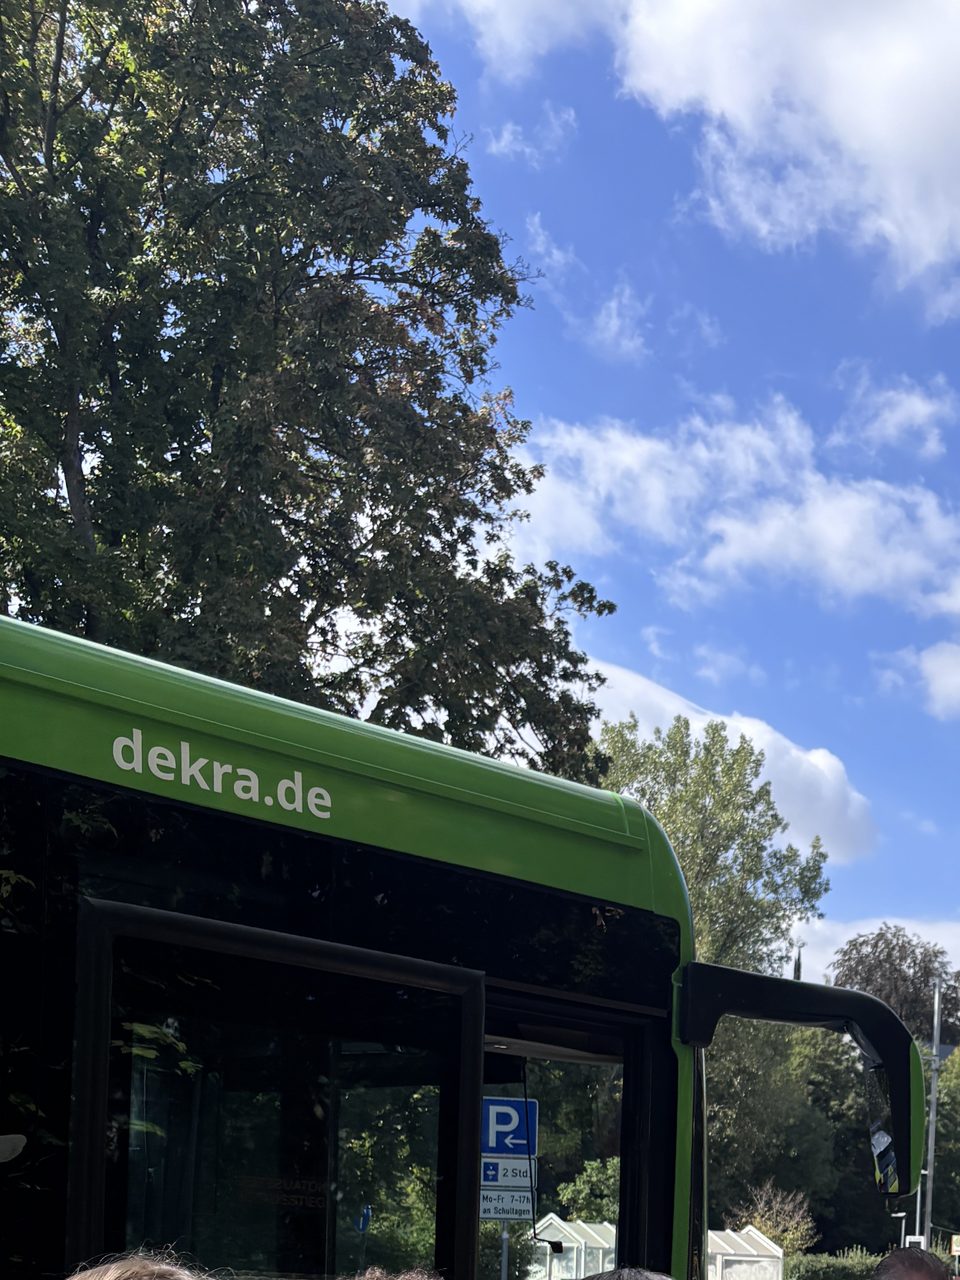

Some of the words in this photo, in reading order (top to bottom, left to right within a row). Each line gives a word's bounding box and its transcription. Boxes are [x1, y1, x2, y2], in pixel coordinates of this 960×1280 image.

[112, 728, 333, 820] dekra.de
[489, 1105, 520, 1148] P
[503, 1168, 509, 1178] 2
[482, 1194, 504, 1203] Mo-Fr
[510, 1195, 531, 1204] 7-17h
[494, 1206, 530, 1217] Schultagen
